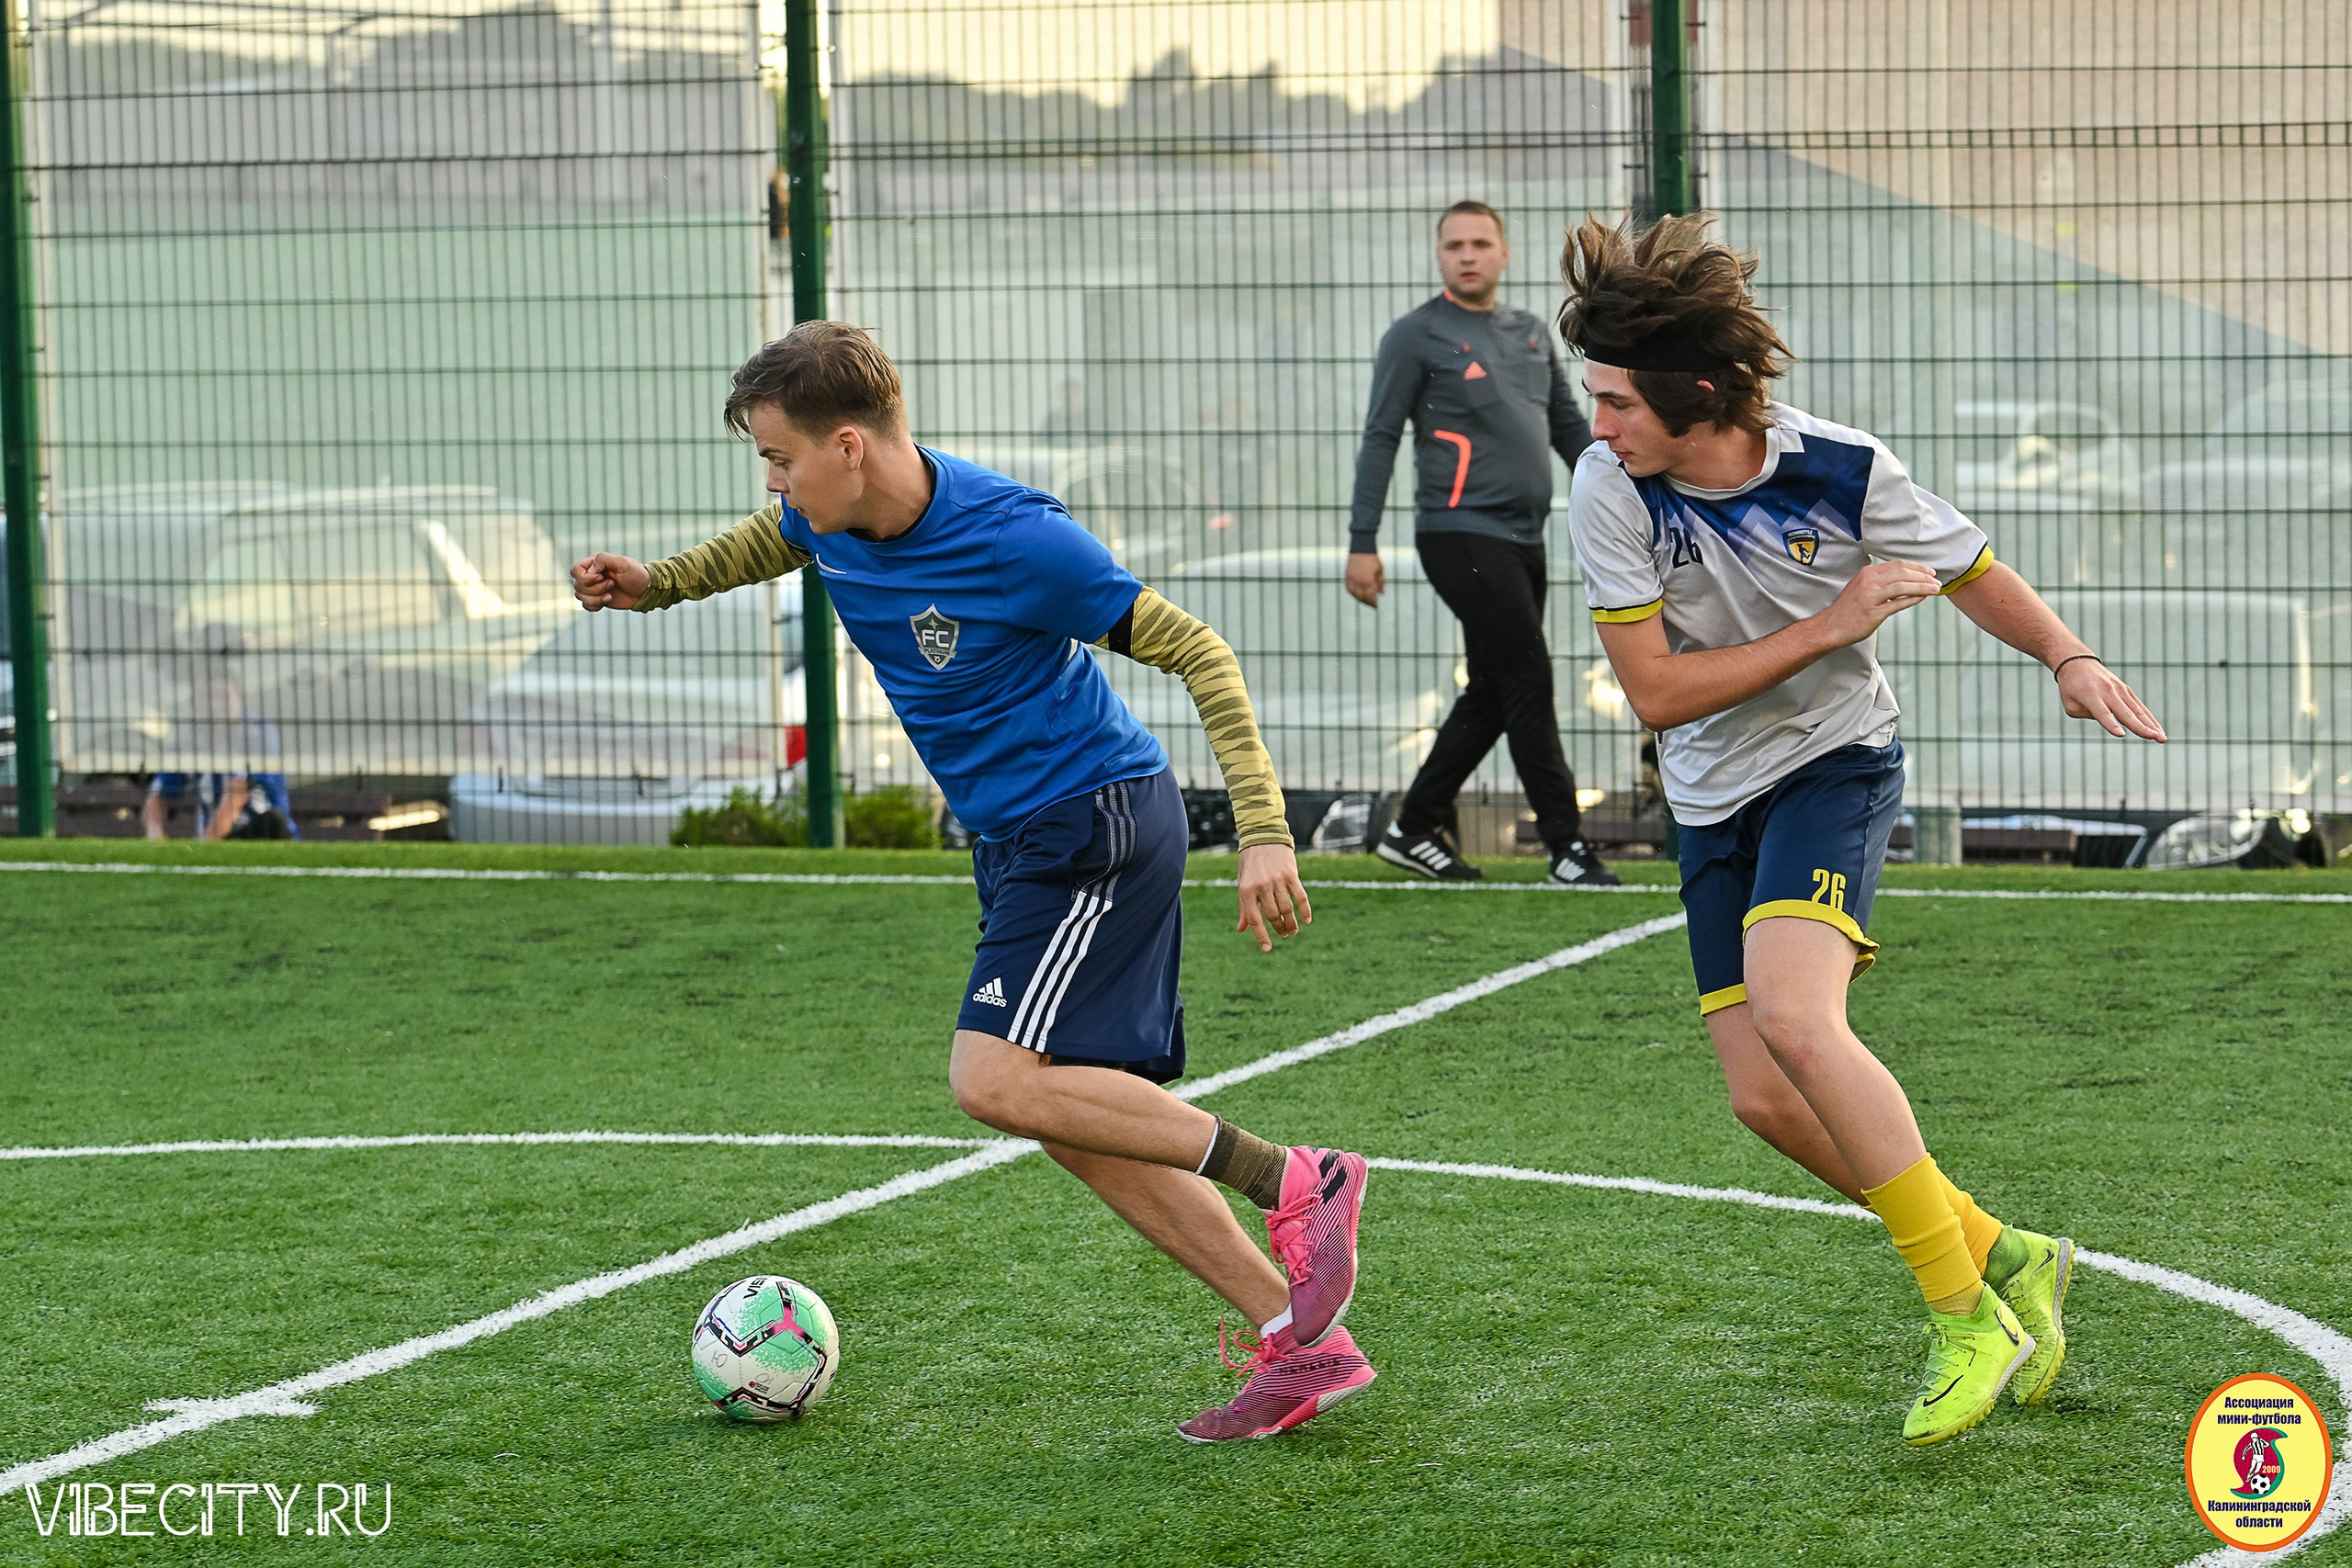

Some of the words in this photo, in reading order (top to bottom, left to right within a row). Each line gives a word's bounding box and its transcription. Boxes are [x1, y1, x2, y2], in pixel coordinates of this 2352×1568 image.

[1668, 526, 1704, 569] 26
[922, 629, 950, 648] FC
[1812, 868, 1847, 911] 26
[972, 992, 1007, 1008] adidas
